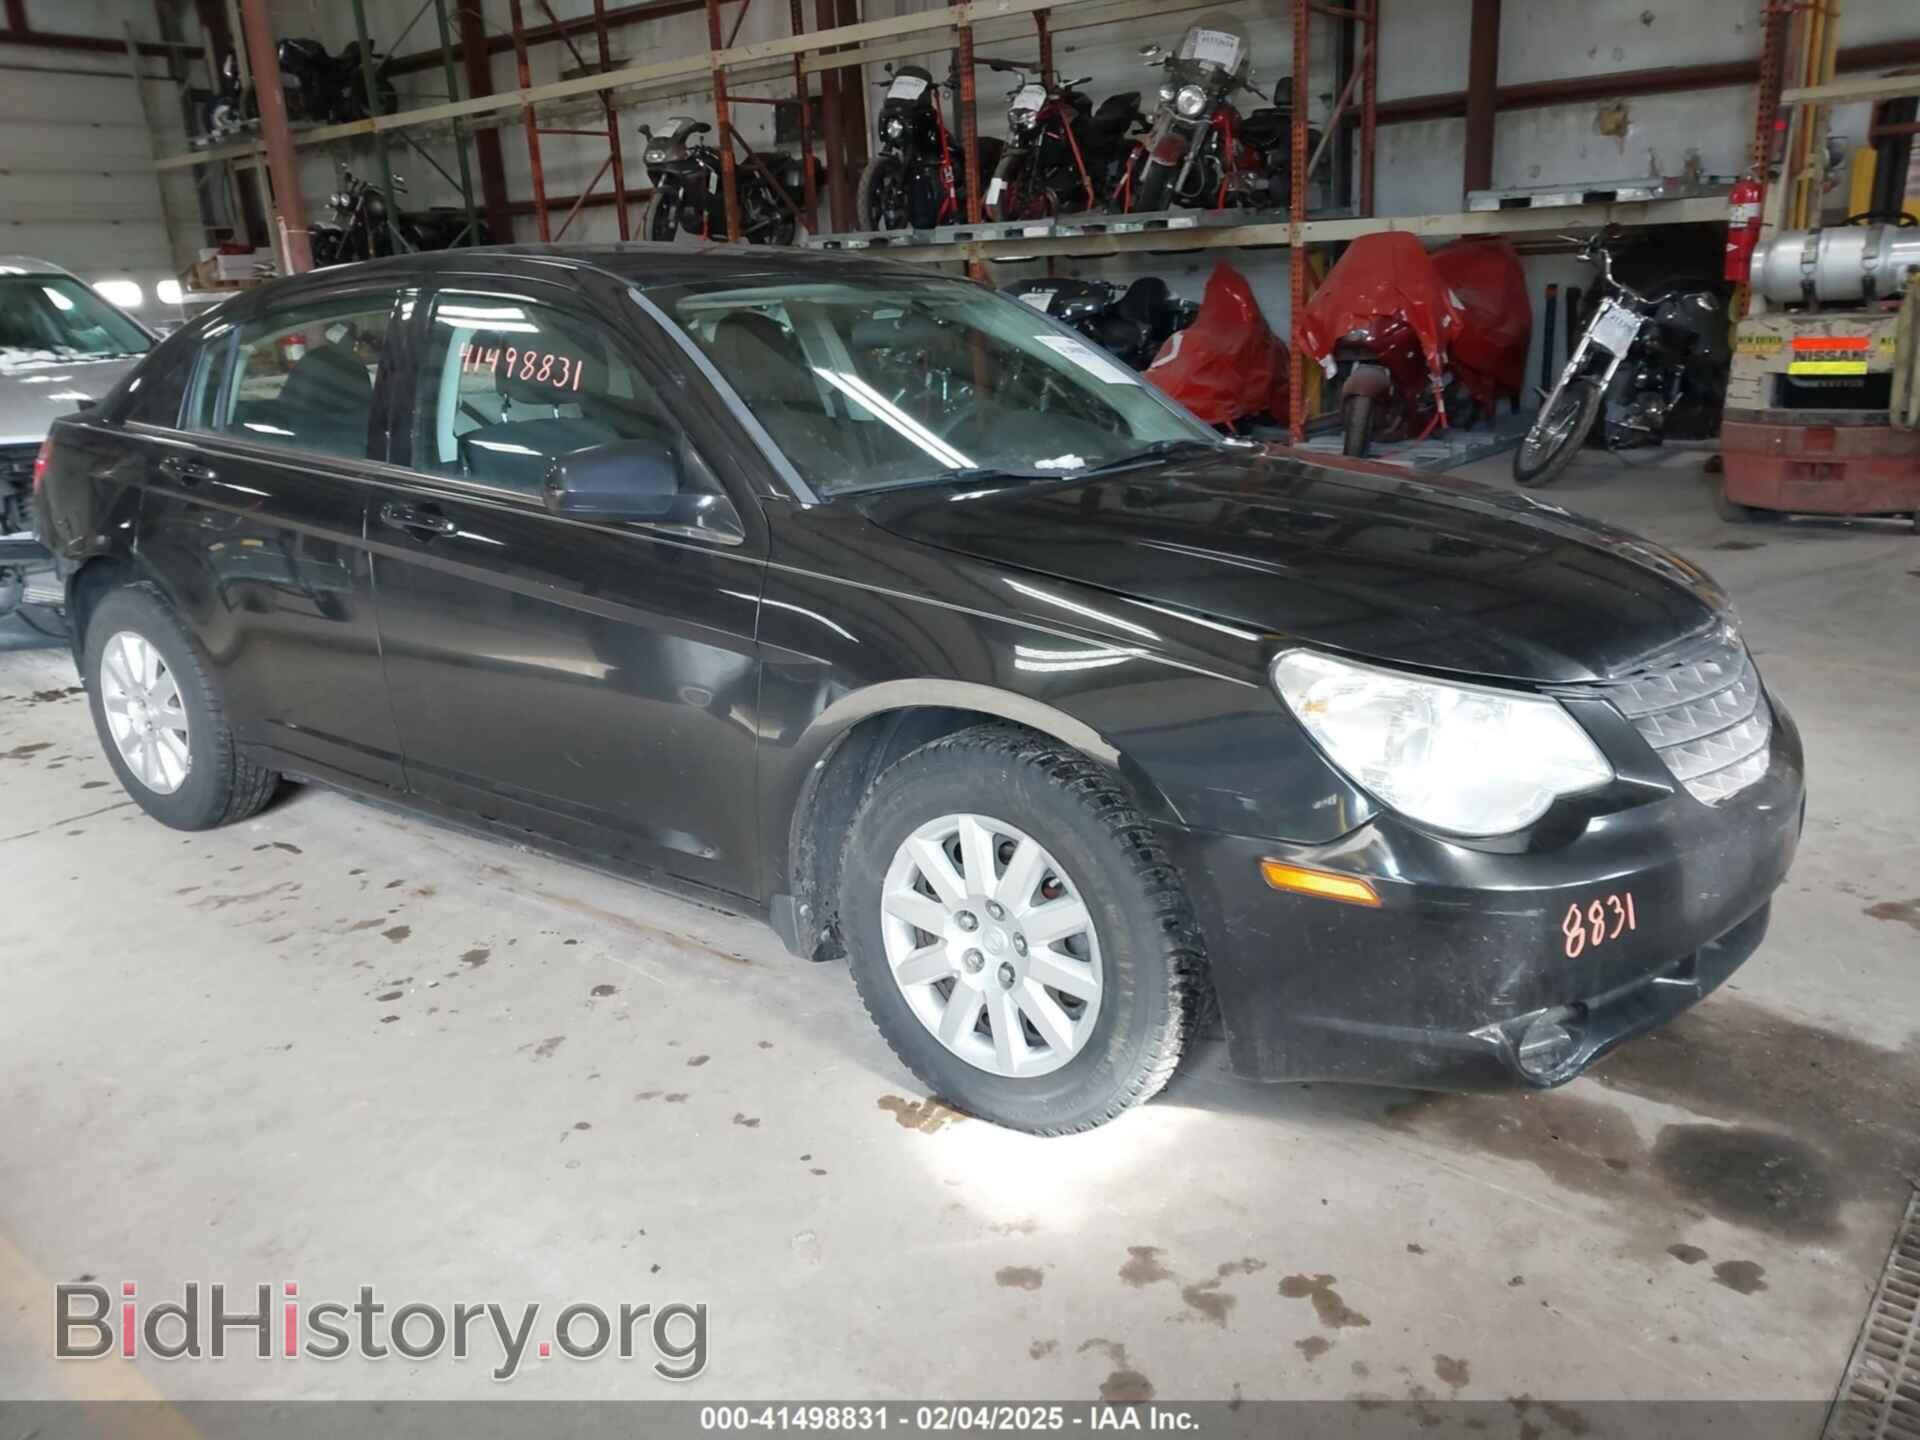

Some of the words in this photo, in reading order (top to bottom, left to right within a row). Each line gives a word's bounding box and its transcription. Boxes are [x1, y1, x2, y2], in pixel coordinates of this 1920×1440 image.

[458, 342, 582, 391] 41498831
[1794, 350, 1866, 362] NISSAN
[1562, 892, 1636, 958] 8831
